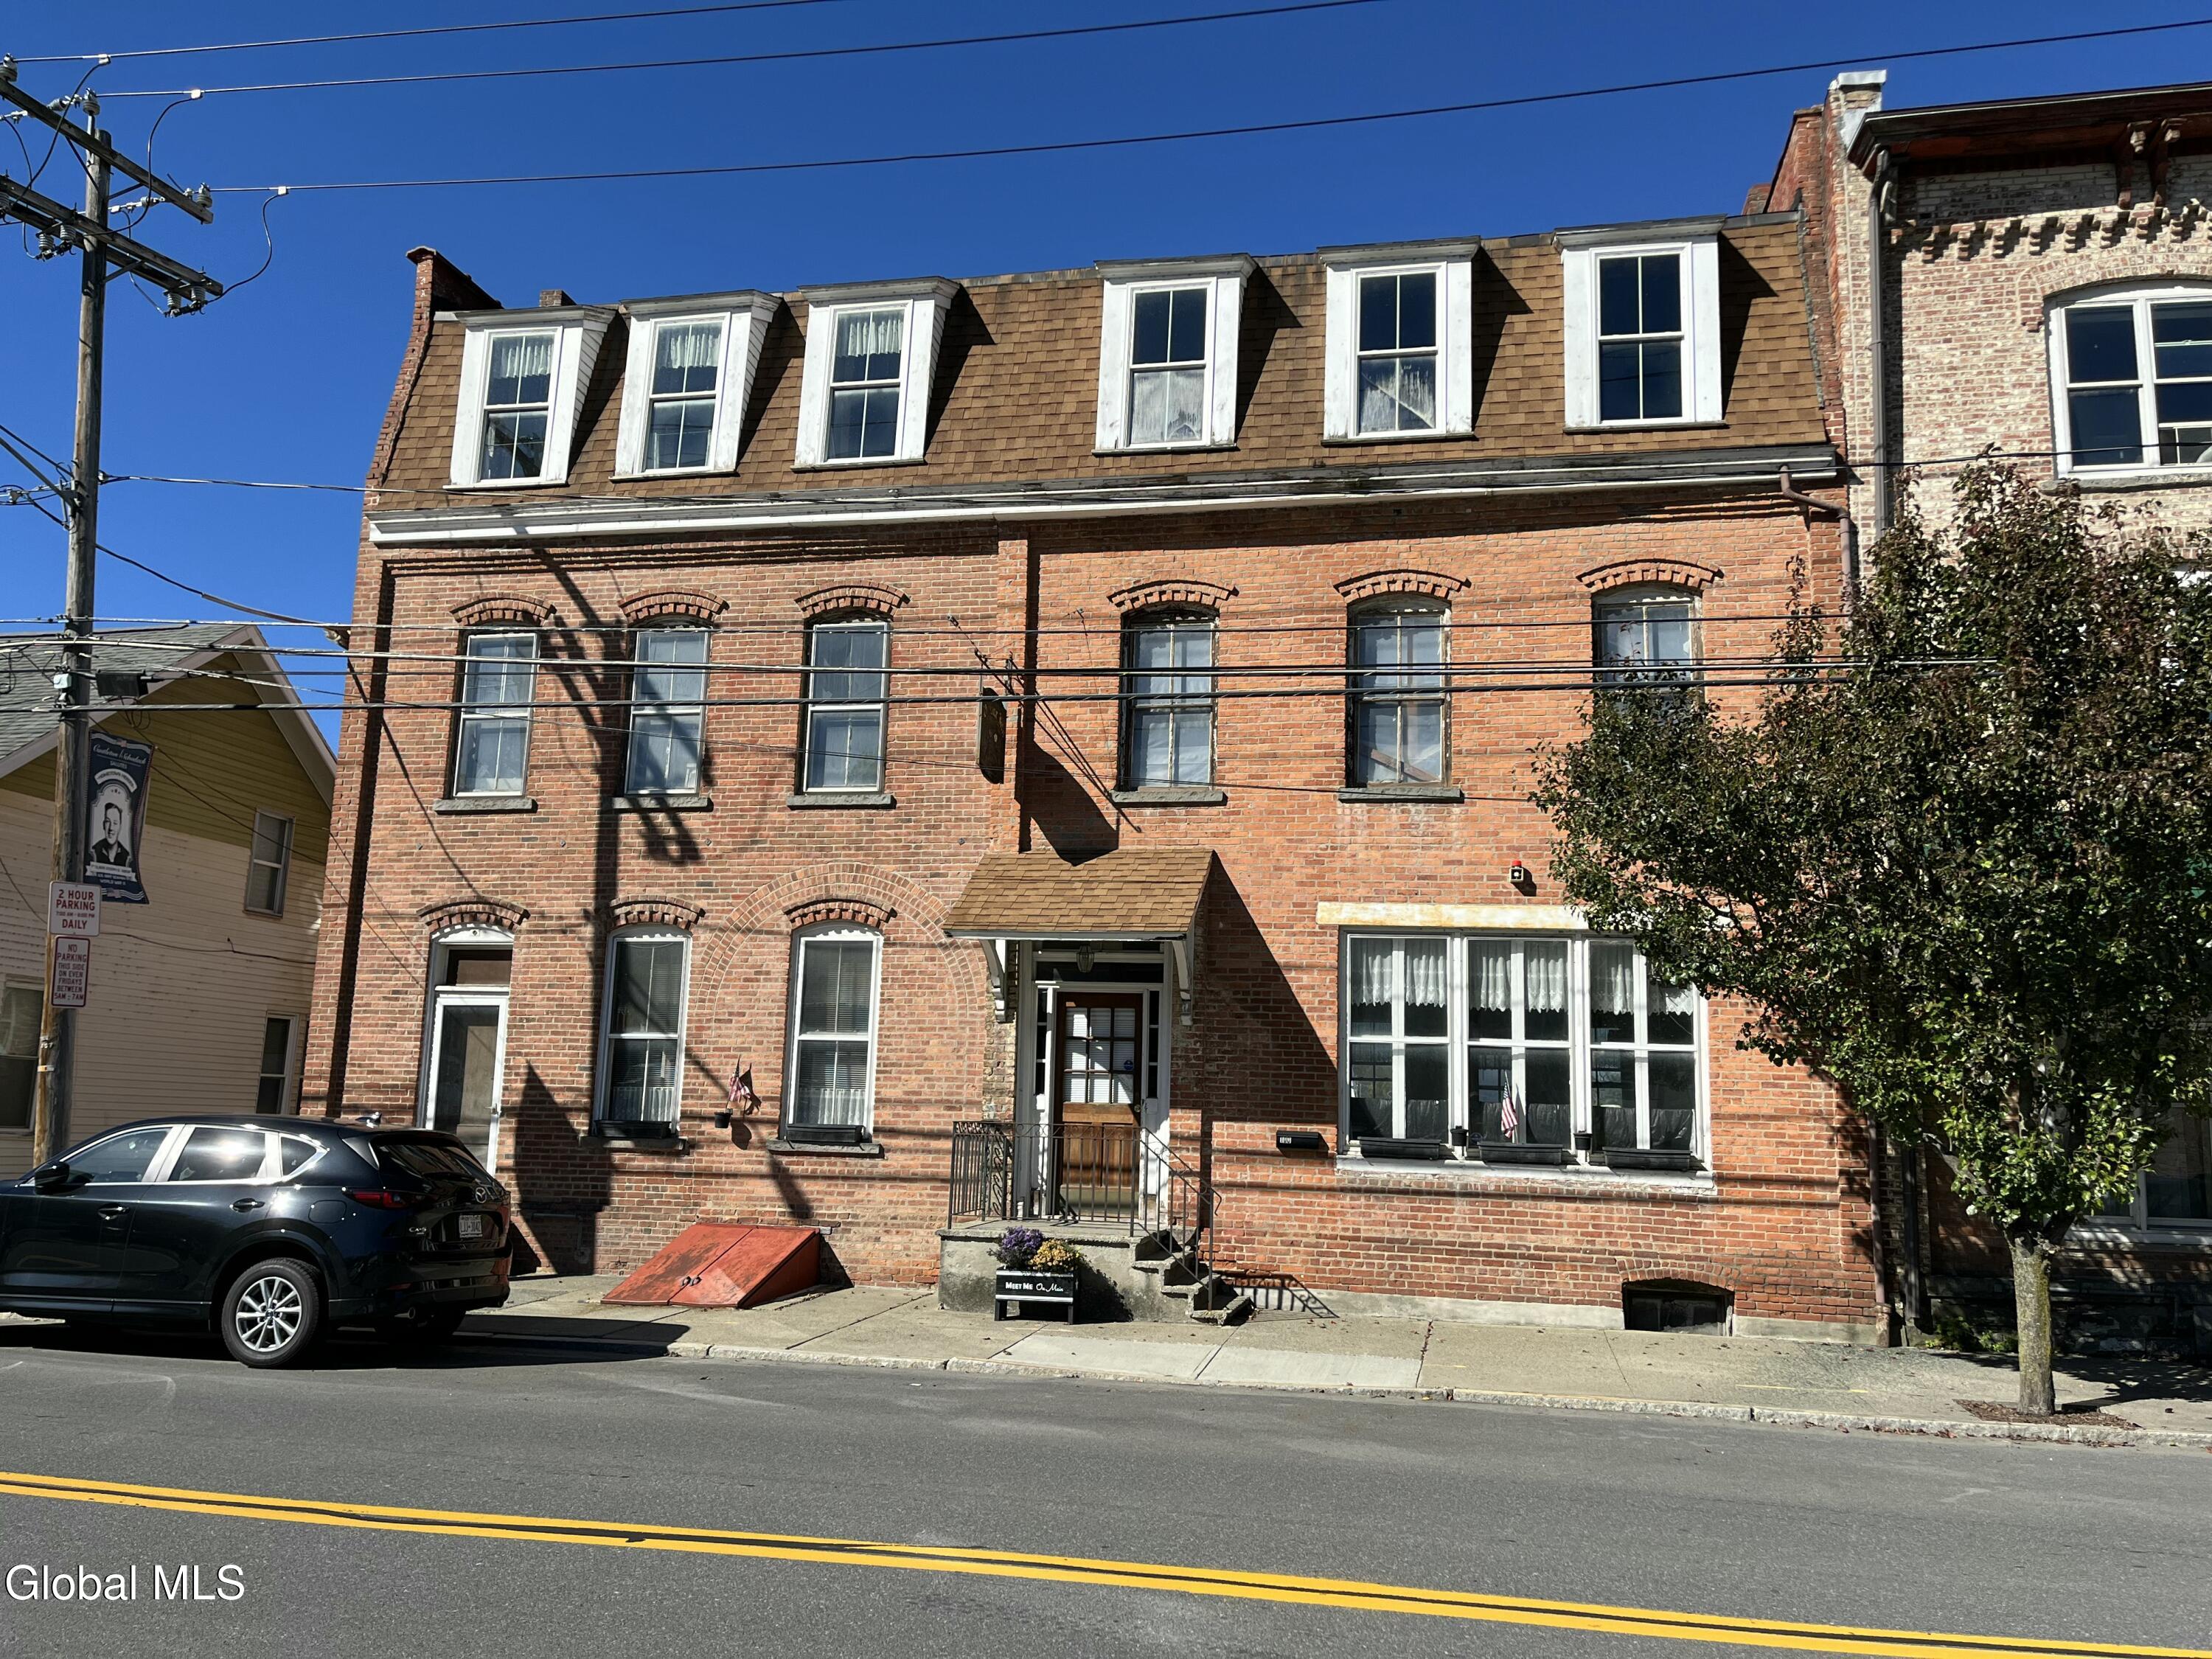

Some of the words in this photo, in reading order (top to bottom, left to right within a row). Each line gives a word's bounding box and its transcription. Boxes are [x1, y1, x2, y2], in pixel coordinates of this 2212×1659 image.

[59, 889, 64, 898] 2
[68, 890, 94, 900] HOUR
[56, 900, 95, 911] PARKING
[62, 919, 88, 929] DAILY
[68, 944, 77, 953] NO
[57, 953, 86, 962] PARKING
[57, 985, 83, 993] BETWEEN
[1005, 1281, 1022, 1290] MEET
[1045, 1283, 1063, 1292] Main
